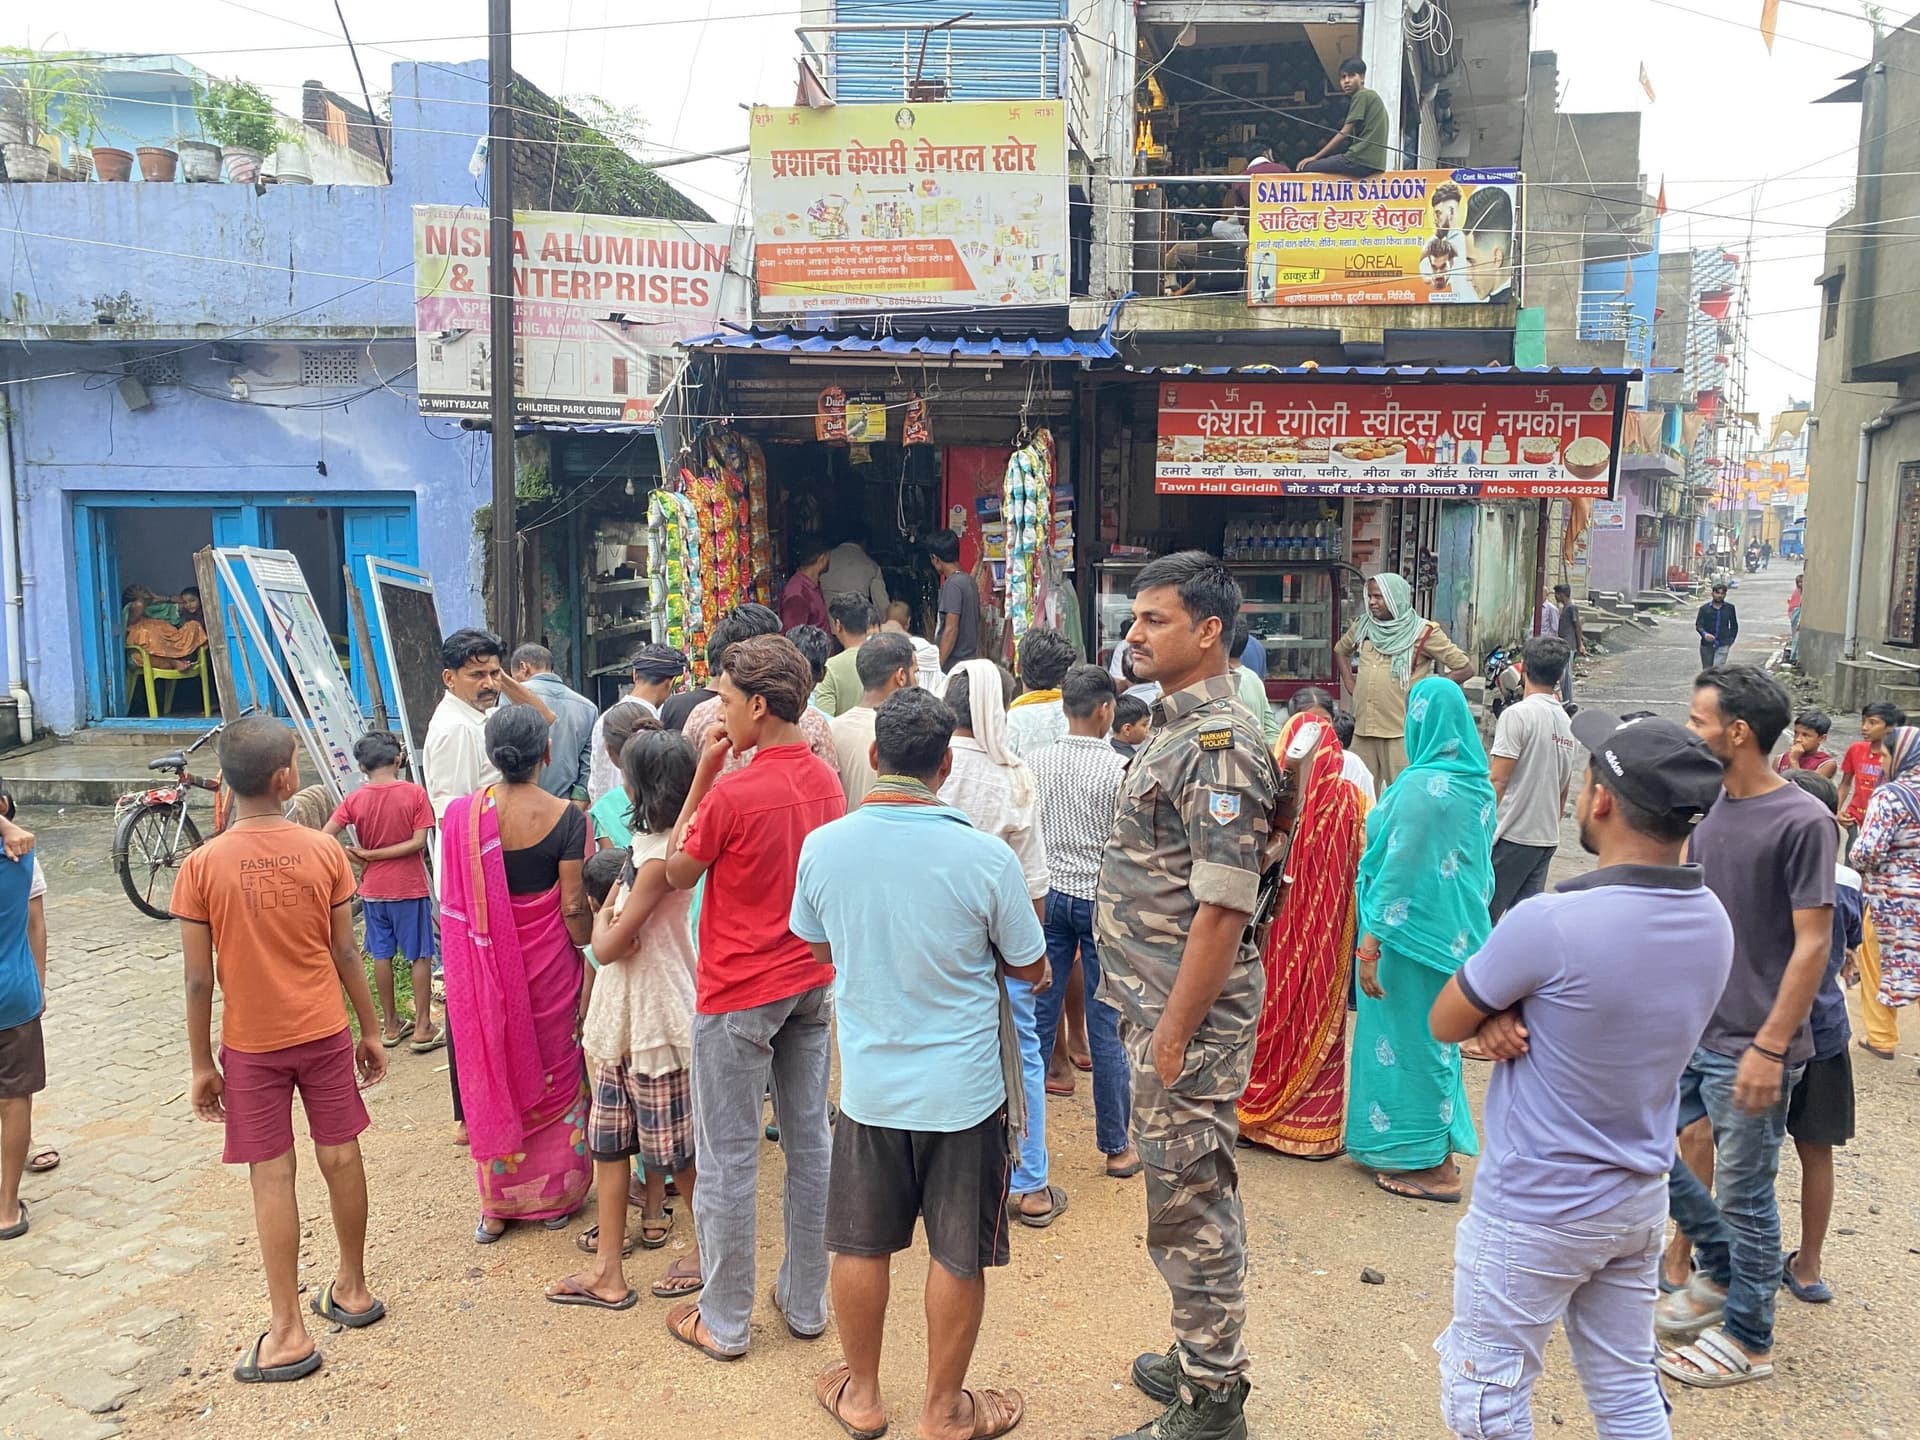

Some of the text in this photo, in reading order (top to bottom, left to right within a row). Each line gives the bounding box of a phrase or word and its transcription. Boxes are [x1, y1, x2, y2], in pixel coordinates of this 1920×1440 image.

[770, 136, 1037, 179] प्रशान्त केशरी जेनरल स्टोर
[1257, 178, 1427, 202] SAHIL HAIR SALOON
[1257, 205, 1319, 231] साहिल
[1324, 206, 1368, 230] हेयर
[540, 232, 729, 273] ALUMINIUM
[449, 263, 709, 306] & NTERPRISES
[431, 399, 489, 410] WHITYBAZAR
[516, 402, 560, 413] CHILDREN
[562, 403, 585, 414] PARK
[587, 404, 621, 416] GIRIDIH
[1197, 400, 1266, 436] केशरी
[1276, 400, 1350, 436] रंगोली
[1452, 402, 1487, 439] एवं
[1497, 402, 1582, 440] नमकीन
[1160, 466, 1192, 477] हमारे
[1201, 465, 1226, 477] यहाँ
[1234, 466, 1262, 478] छेना,
[1272, 466, 1306, 478] खोवा,
[1317, 466, 1351, 479] पनीर,
[1363, 466, 1390, 478] मीठा
[1400, 469, 1416, 479] का
[1469, 466, 1498, 479] लिया
[1509, 470, 1540, 479] जाता
[1548, 466, 1565, 479] है।
[1159, 481, 1279, 493] Tawn Hall Giridih
[1287, 482, 1307, 493] नोट
[1318, 482, 1342, 494] यहाँ
[1377, 484, 1399, 494] केक
[1402, 482, 1417, 494] भी
[1419, 482, 1456, 495] मिलता
[1457, 482, 1474, 495] है।
[1486, 484, 1519, 494] Mob.
[1530, 485, 1608, 495] 8092442828
[1203, 739, 1230, 749] POLICE
[240, 854, 301, 870] FASHION
